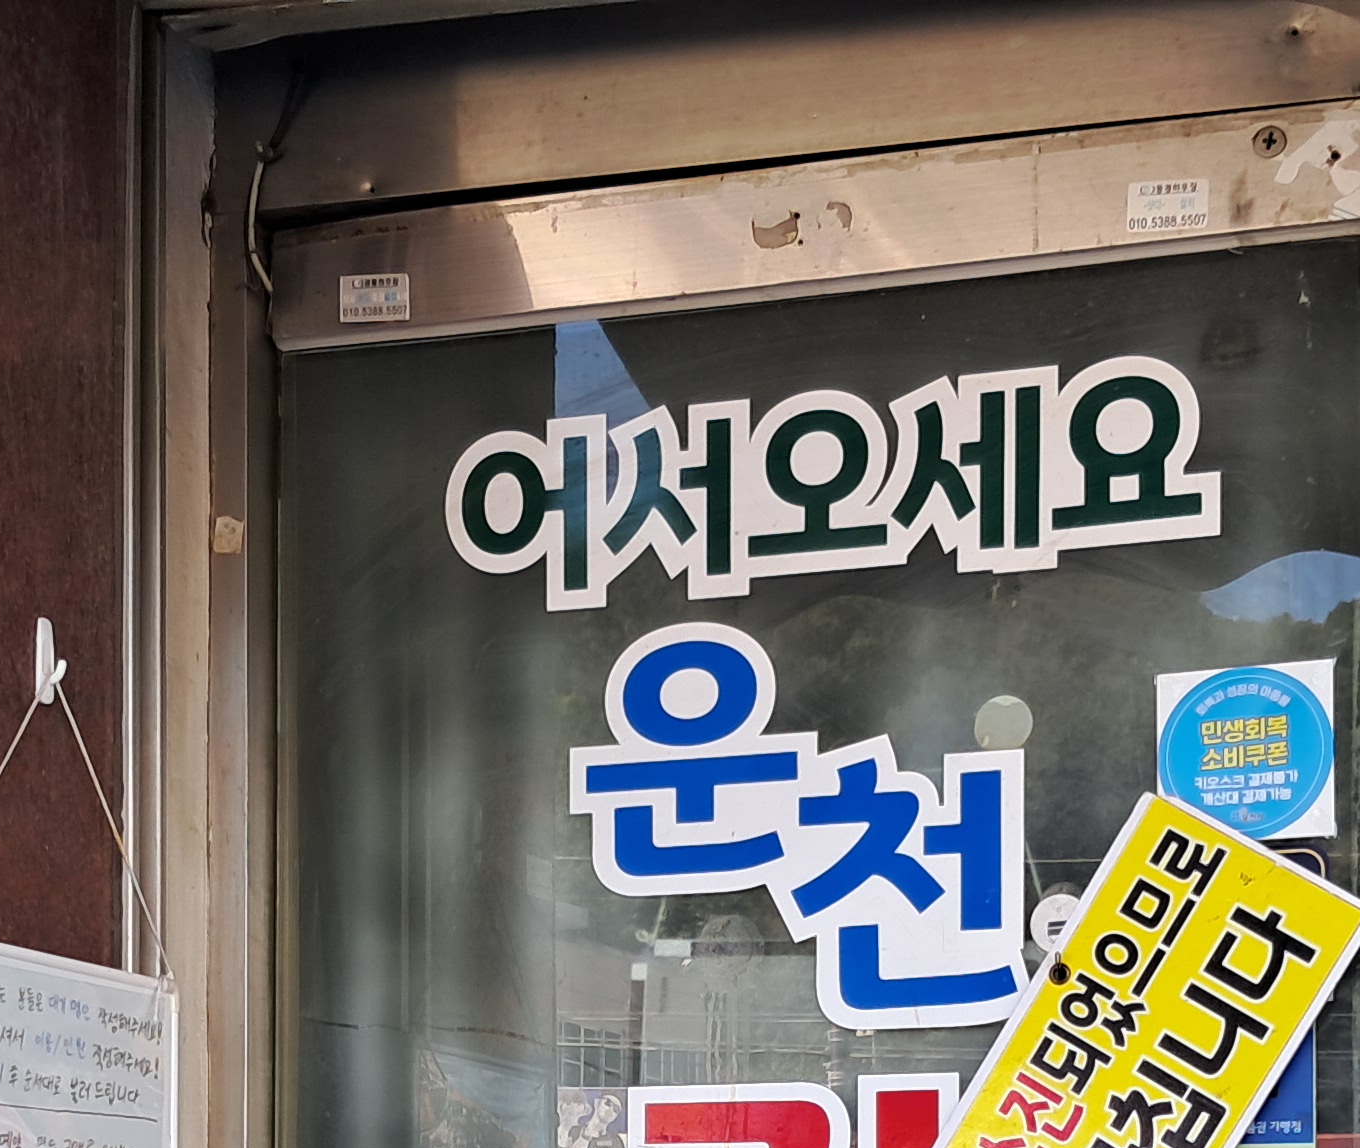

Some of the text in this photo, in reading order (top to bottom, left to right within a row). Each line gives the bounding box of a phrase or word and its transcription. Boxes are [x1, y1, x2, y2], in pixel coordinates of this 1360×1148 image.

[462, 375, 1203, 592] 어서오세요
[1200, 741, 1289, 771] 소비쿠폰
[1193, 774, 1245, 790] 키오스크
[1200, 786, 1293, 806] 계산대 결제가능
[586, 641, 1018, 1011] 운천
[18, 987, 44, 1012] 분들은
[24, 1070, 62, 1096] 순서대로
[70, 1080, 90, 1105] 불러
[94, 1081, 141, 1106] 드립니다
